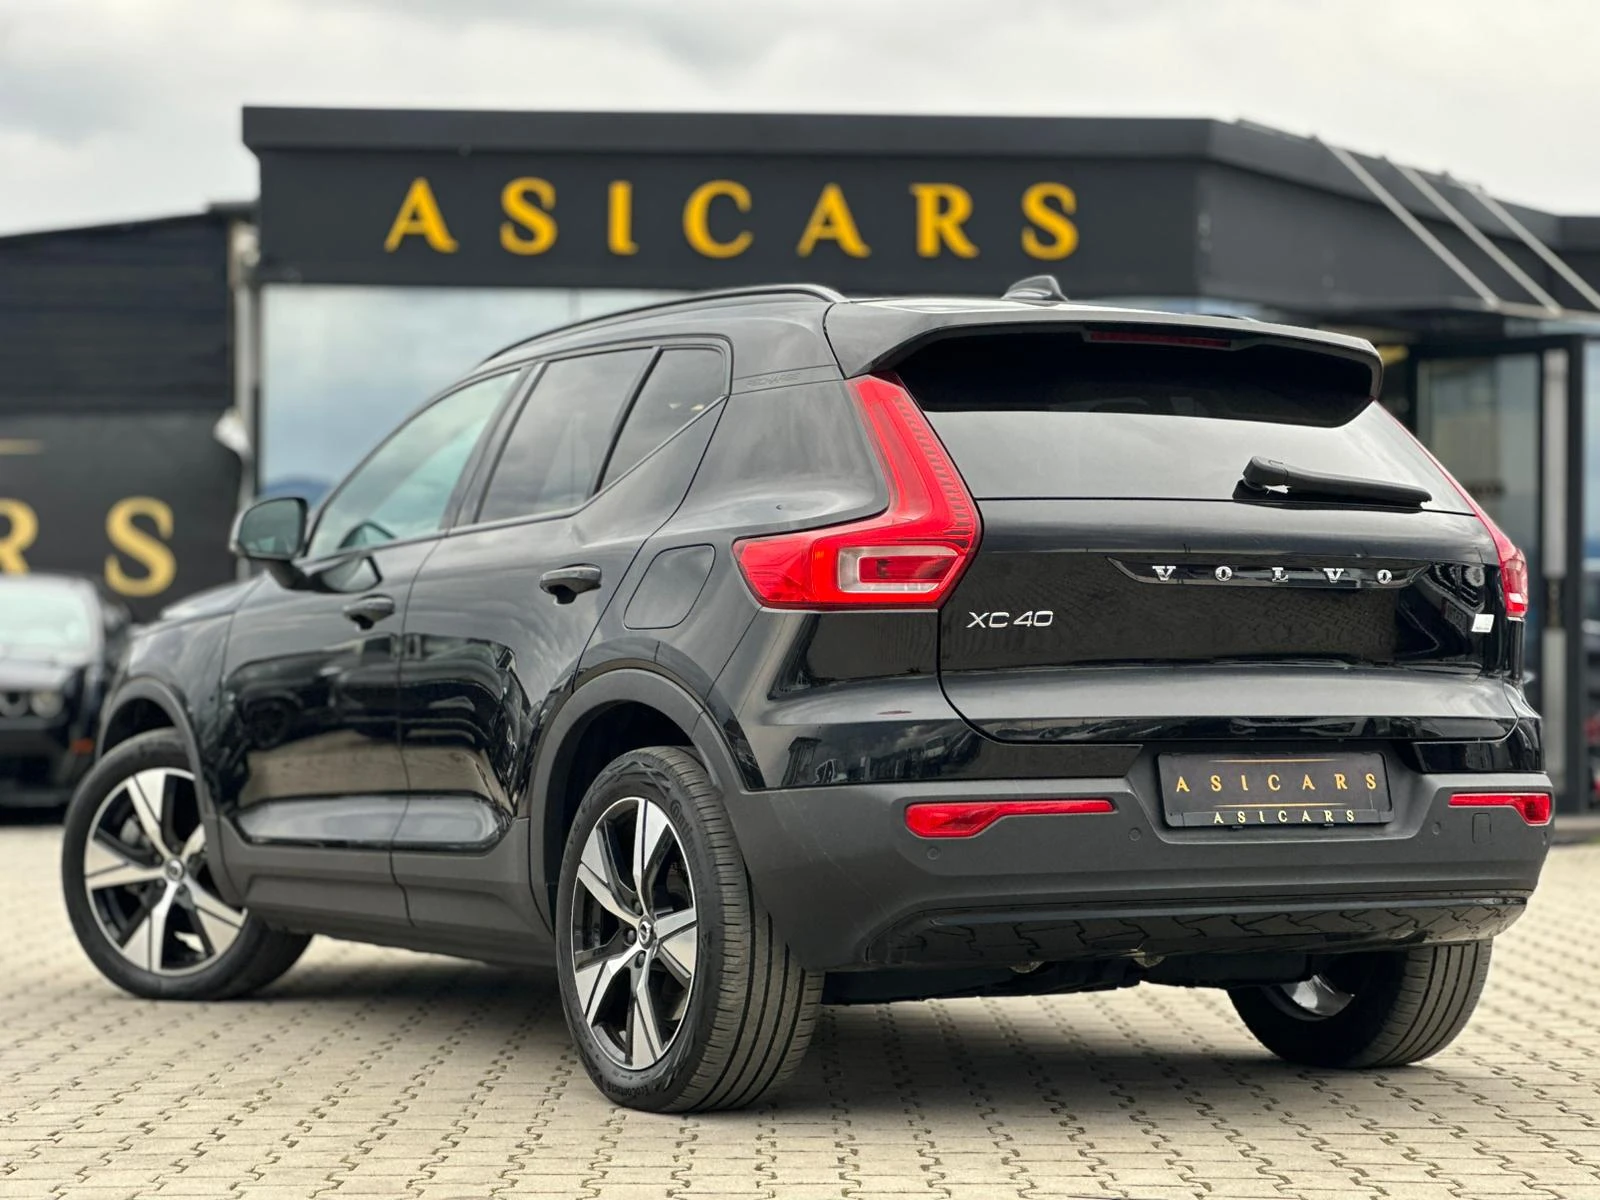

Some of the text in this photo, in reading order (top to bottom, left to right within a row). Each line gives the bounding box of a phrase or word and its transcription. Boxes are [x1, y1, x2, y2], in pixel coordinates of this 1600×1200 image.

[384, 177, 1078, 260] ASICARS
[1152, 565, 1393, 585] VOLVO
[966, 609, 1054, 629] XC40
[1176, 773, 1377, 793] ASICARS
[1213, 809, 1355, 824] ASICARS
